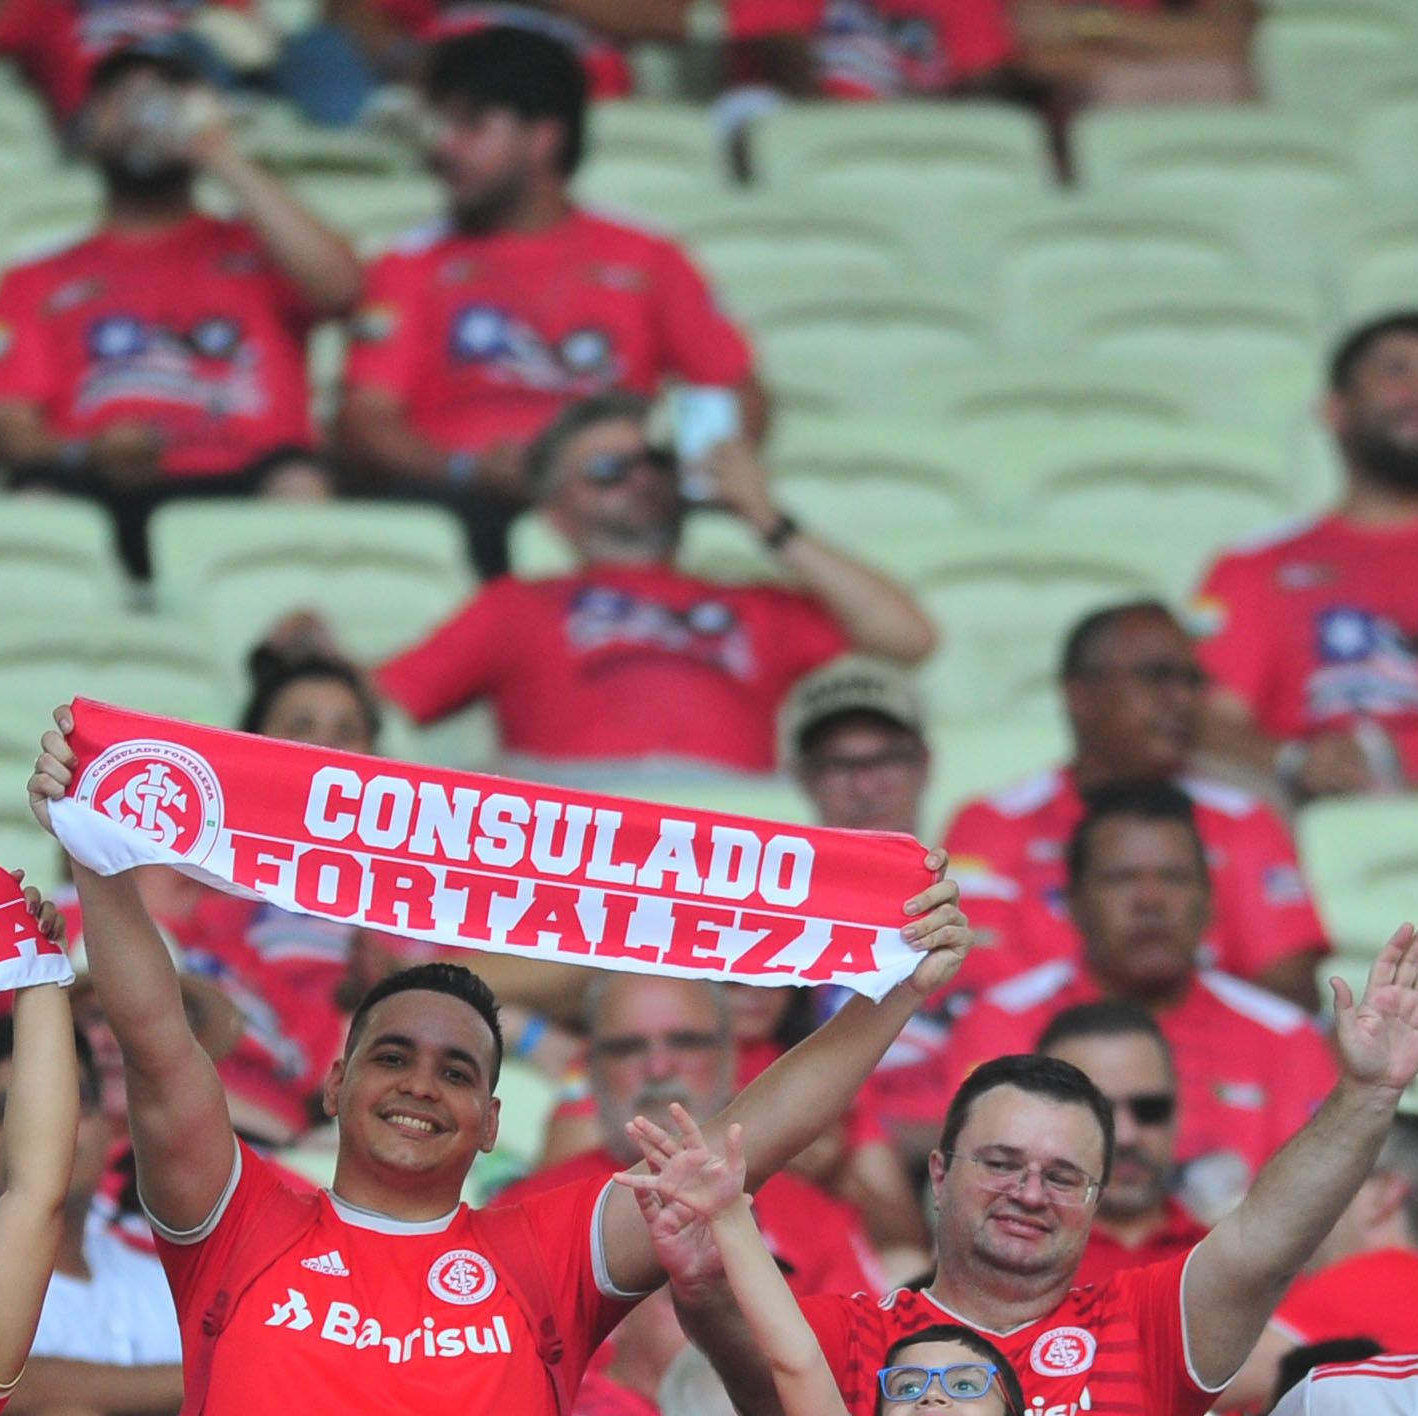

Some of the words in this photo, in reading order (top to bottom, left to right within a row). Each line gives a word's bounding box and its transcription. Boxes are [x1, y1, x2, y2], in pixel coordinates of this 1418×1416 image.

[303, 765, 815, 908] CONSULADO
[229, 832, 884, 981] FORTALEZA
[300, 1257, 350, 1278] adidas
[319, 1301, 512, 1364] Banrisul
